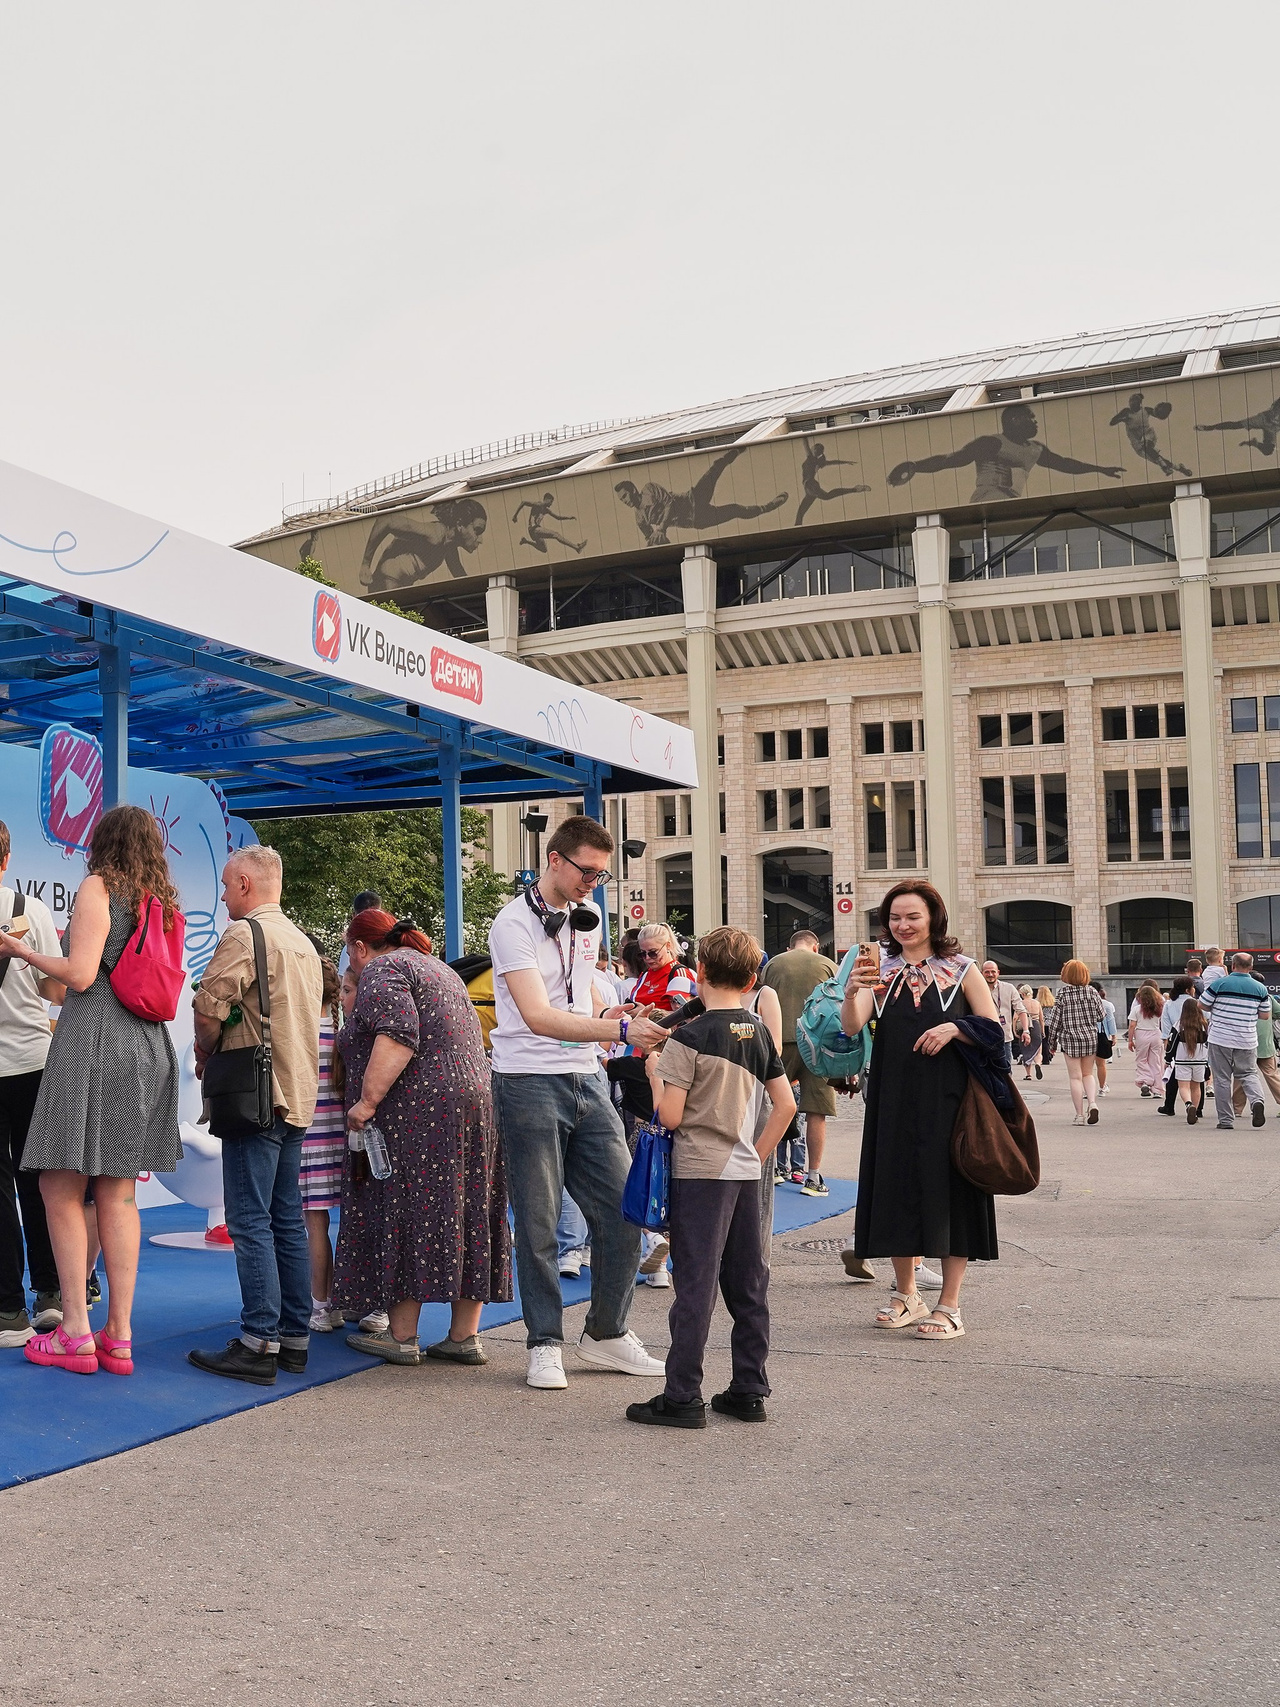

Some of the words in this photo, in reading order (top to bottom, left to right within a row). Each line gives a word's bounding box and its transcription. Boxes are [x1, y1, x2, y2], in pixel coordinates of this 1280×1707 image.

[347, 619, 370, 658] VK
[375, 630, 426, 677] Видео
[629, 889, 644, 901] 11
[836, 881, 854, 895] 11
